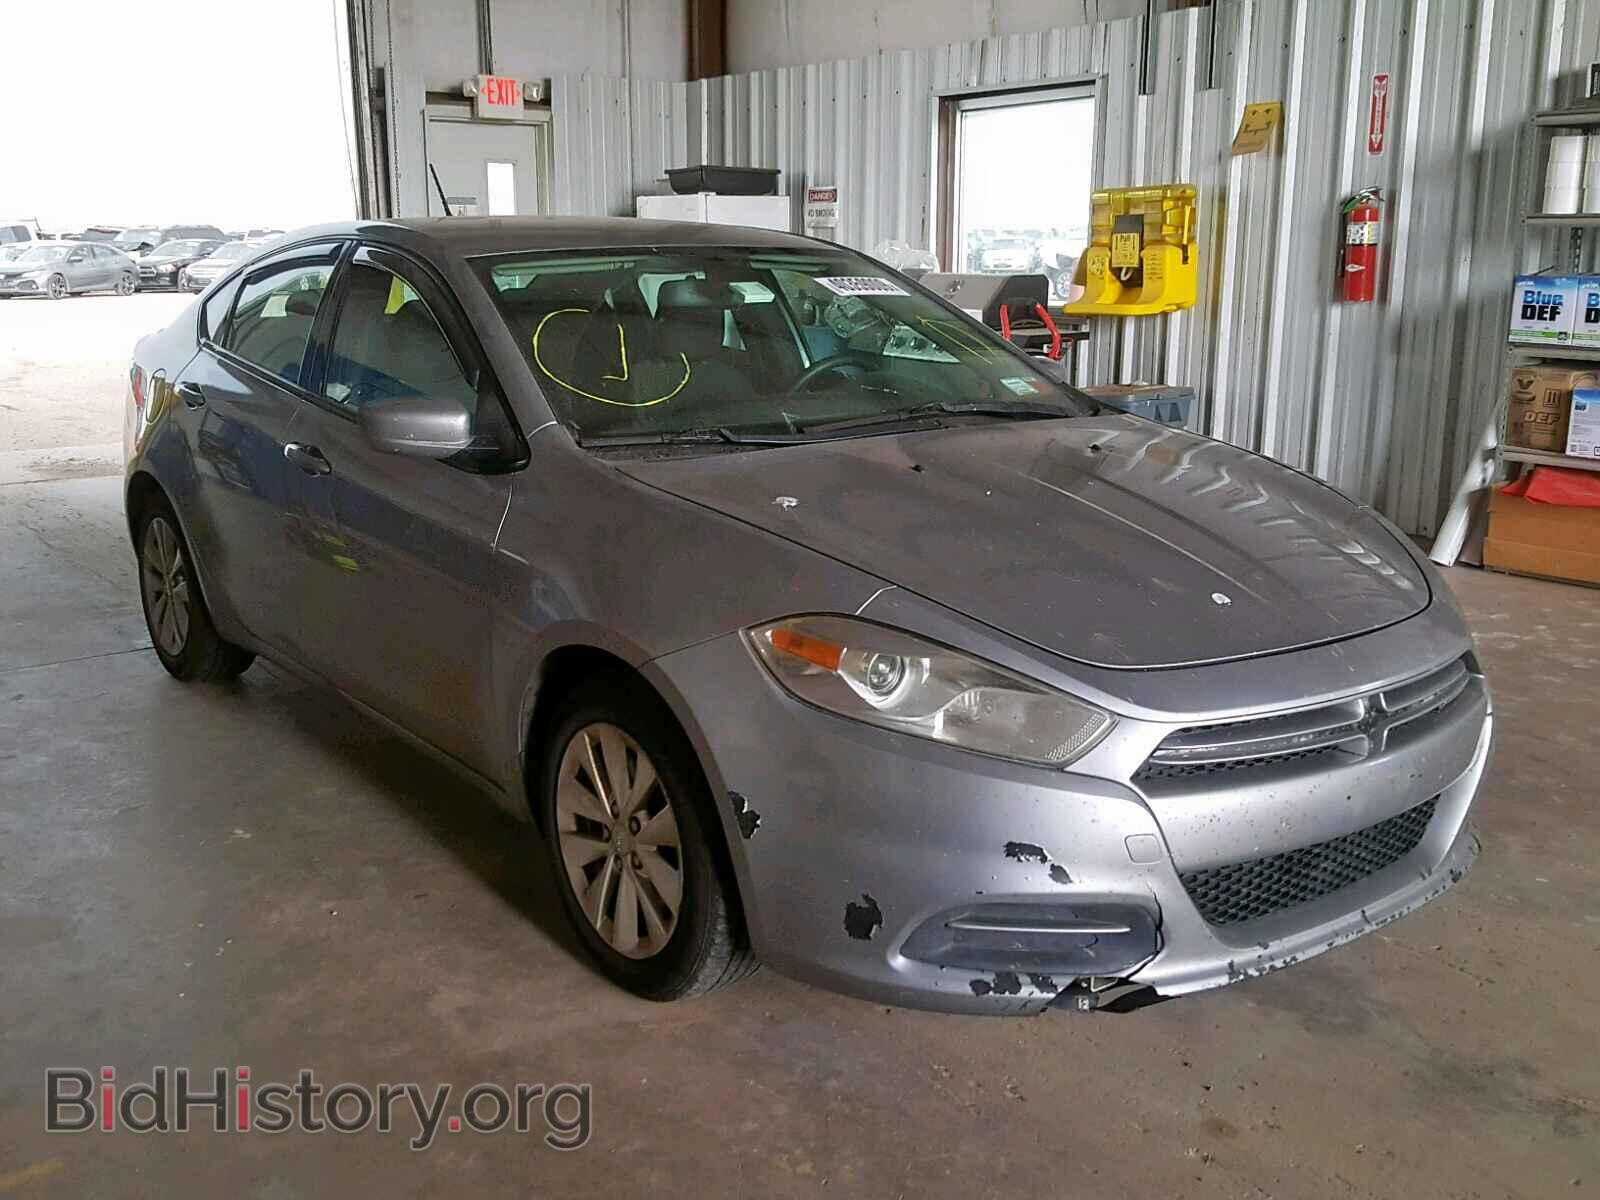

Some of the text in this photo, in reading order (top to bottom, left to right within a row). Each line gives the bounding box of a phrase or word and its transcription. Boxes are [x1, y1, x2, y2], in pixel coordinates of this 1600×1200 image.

[487, 78, 516, 106] EXIT
[810, 190, 835, 201] DANGER
[1523, 290, 1563, 306] Blue
[1521, 304, 1561, 321] DEF
[1524, 411, 1560, 425] DEF
